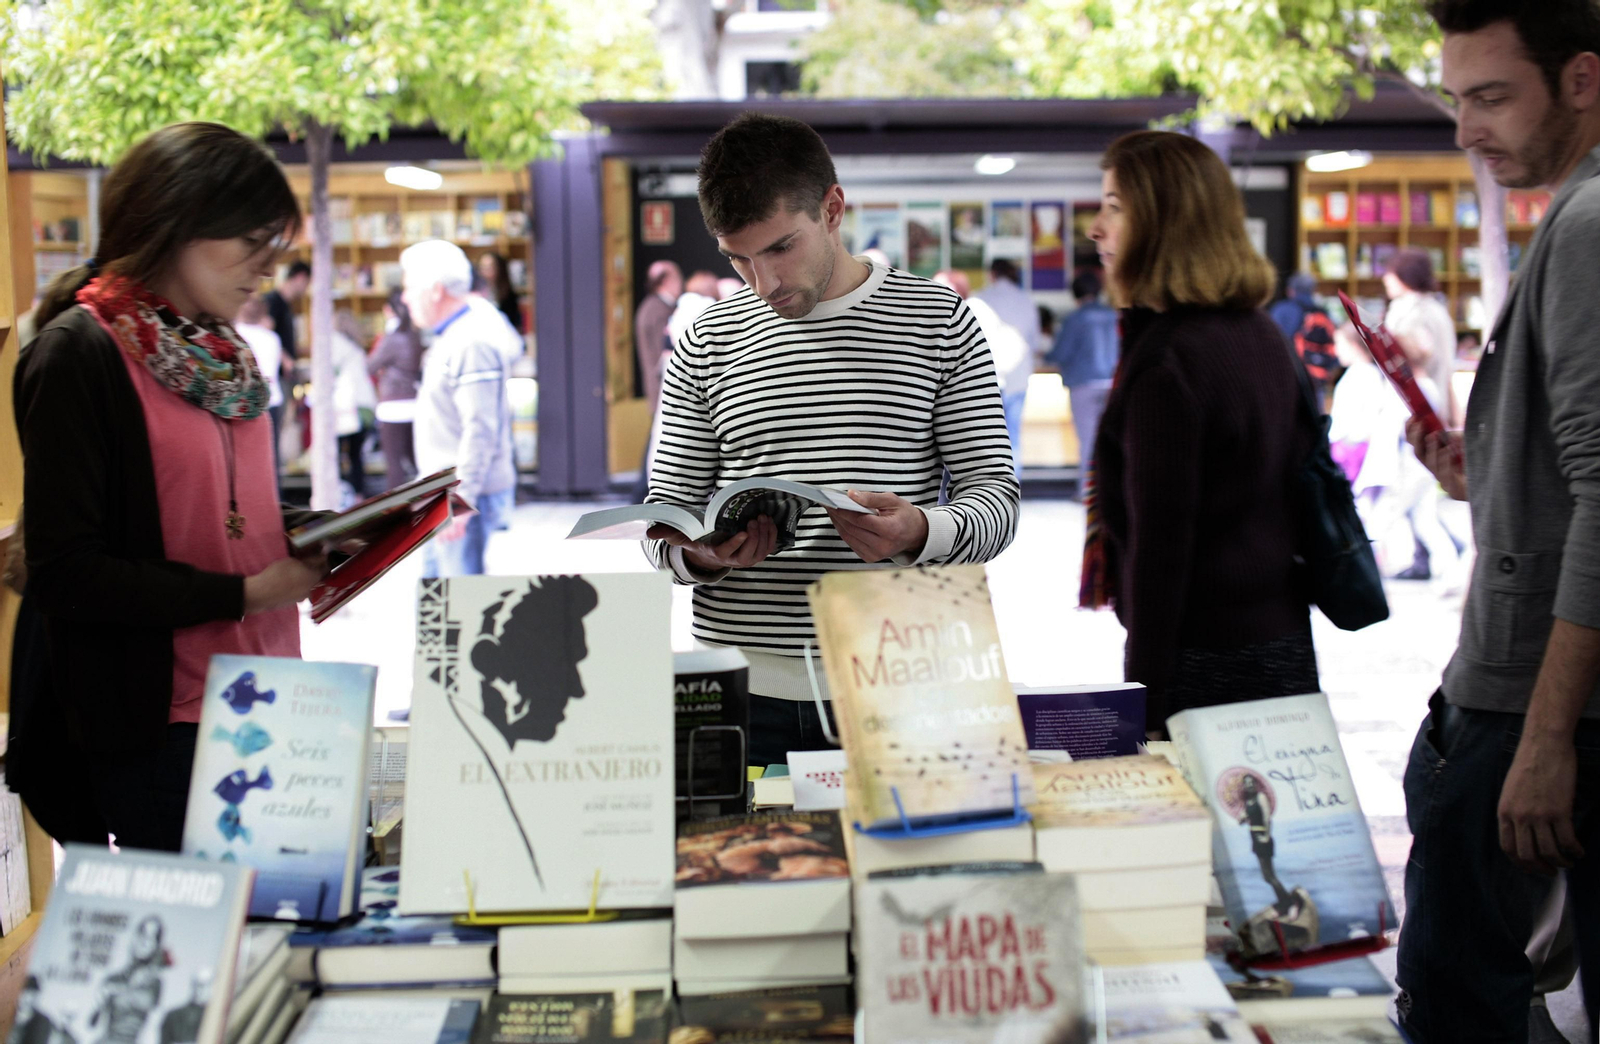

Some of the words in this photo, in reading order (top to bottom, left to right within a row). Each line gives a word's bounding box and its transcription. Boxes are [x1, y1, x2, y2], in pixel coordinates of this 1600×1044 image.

[877, 615, 973, 653] Amin
[851, 642, 1000, 689] Maalouf
[282, 739, 330, 761] Seis
[1242, 733, 1271, 764] El
[283, 771, 344, 793] peces
[459, 763, 493, 785] EL
[503, 757, 662, 784] EXTRANJERO
[261, 796, 332, 819] azules
[65, 861, 130, 899] JUAN
[129, 865, 225, 908] MADRID
[923, 911, 1022, 962] MAPA
[1024, 923, 1048, 952] DE
[886, 974, 921, 1003] LAS
[923, 959, 1057, 1016] VIUDAS
